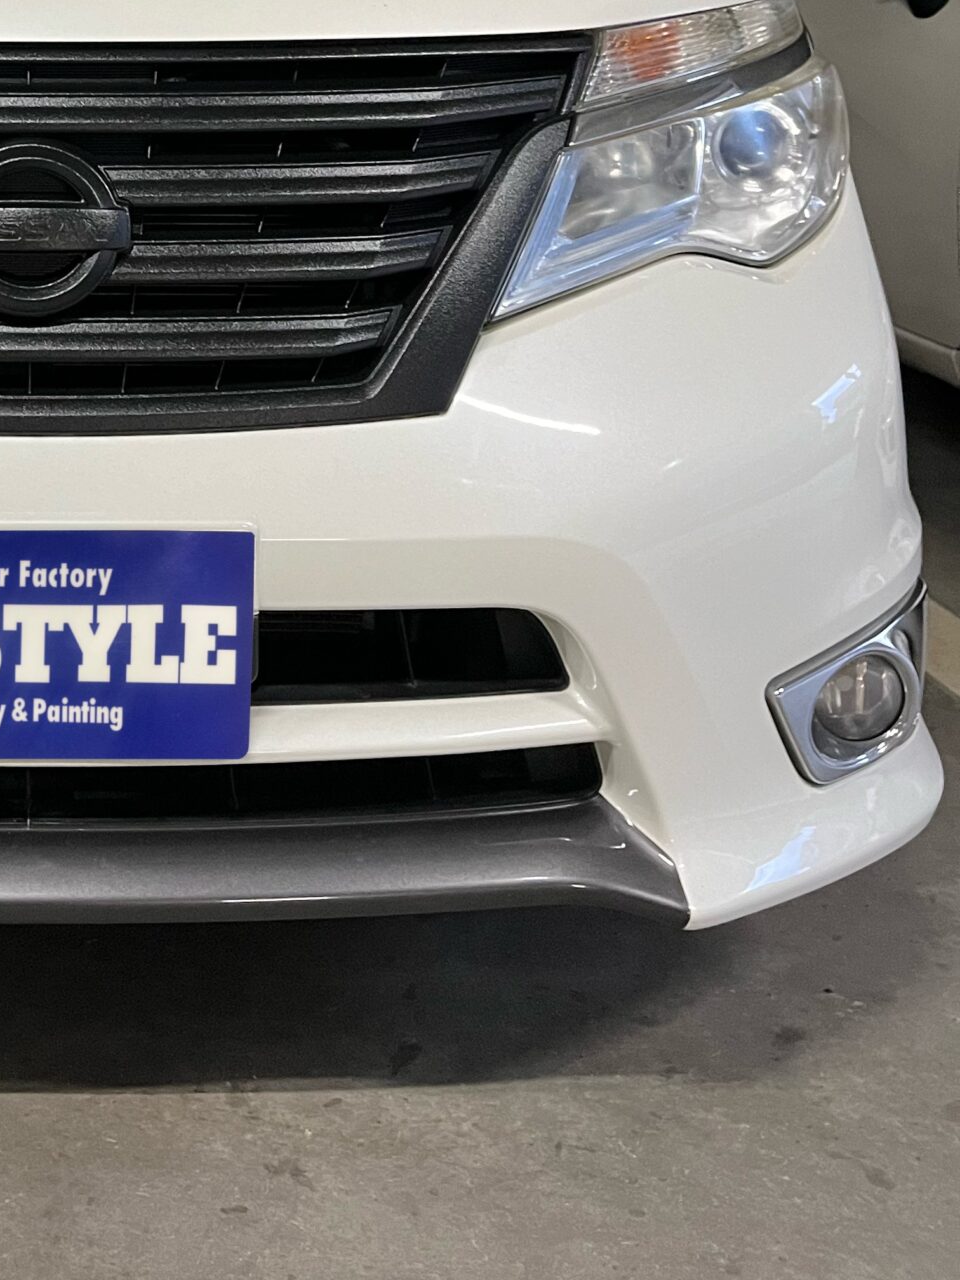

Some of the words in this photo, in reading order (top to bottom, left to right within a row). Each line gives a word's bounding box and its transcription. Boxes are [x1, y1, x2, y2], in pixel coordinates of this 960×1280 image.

[19, 559, 113, 596] Factory
[11, 697, 28, 722] &
[32, 697, 124, 732] Painting
